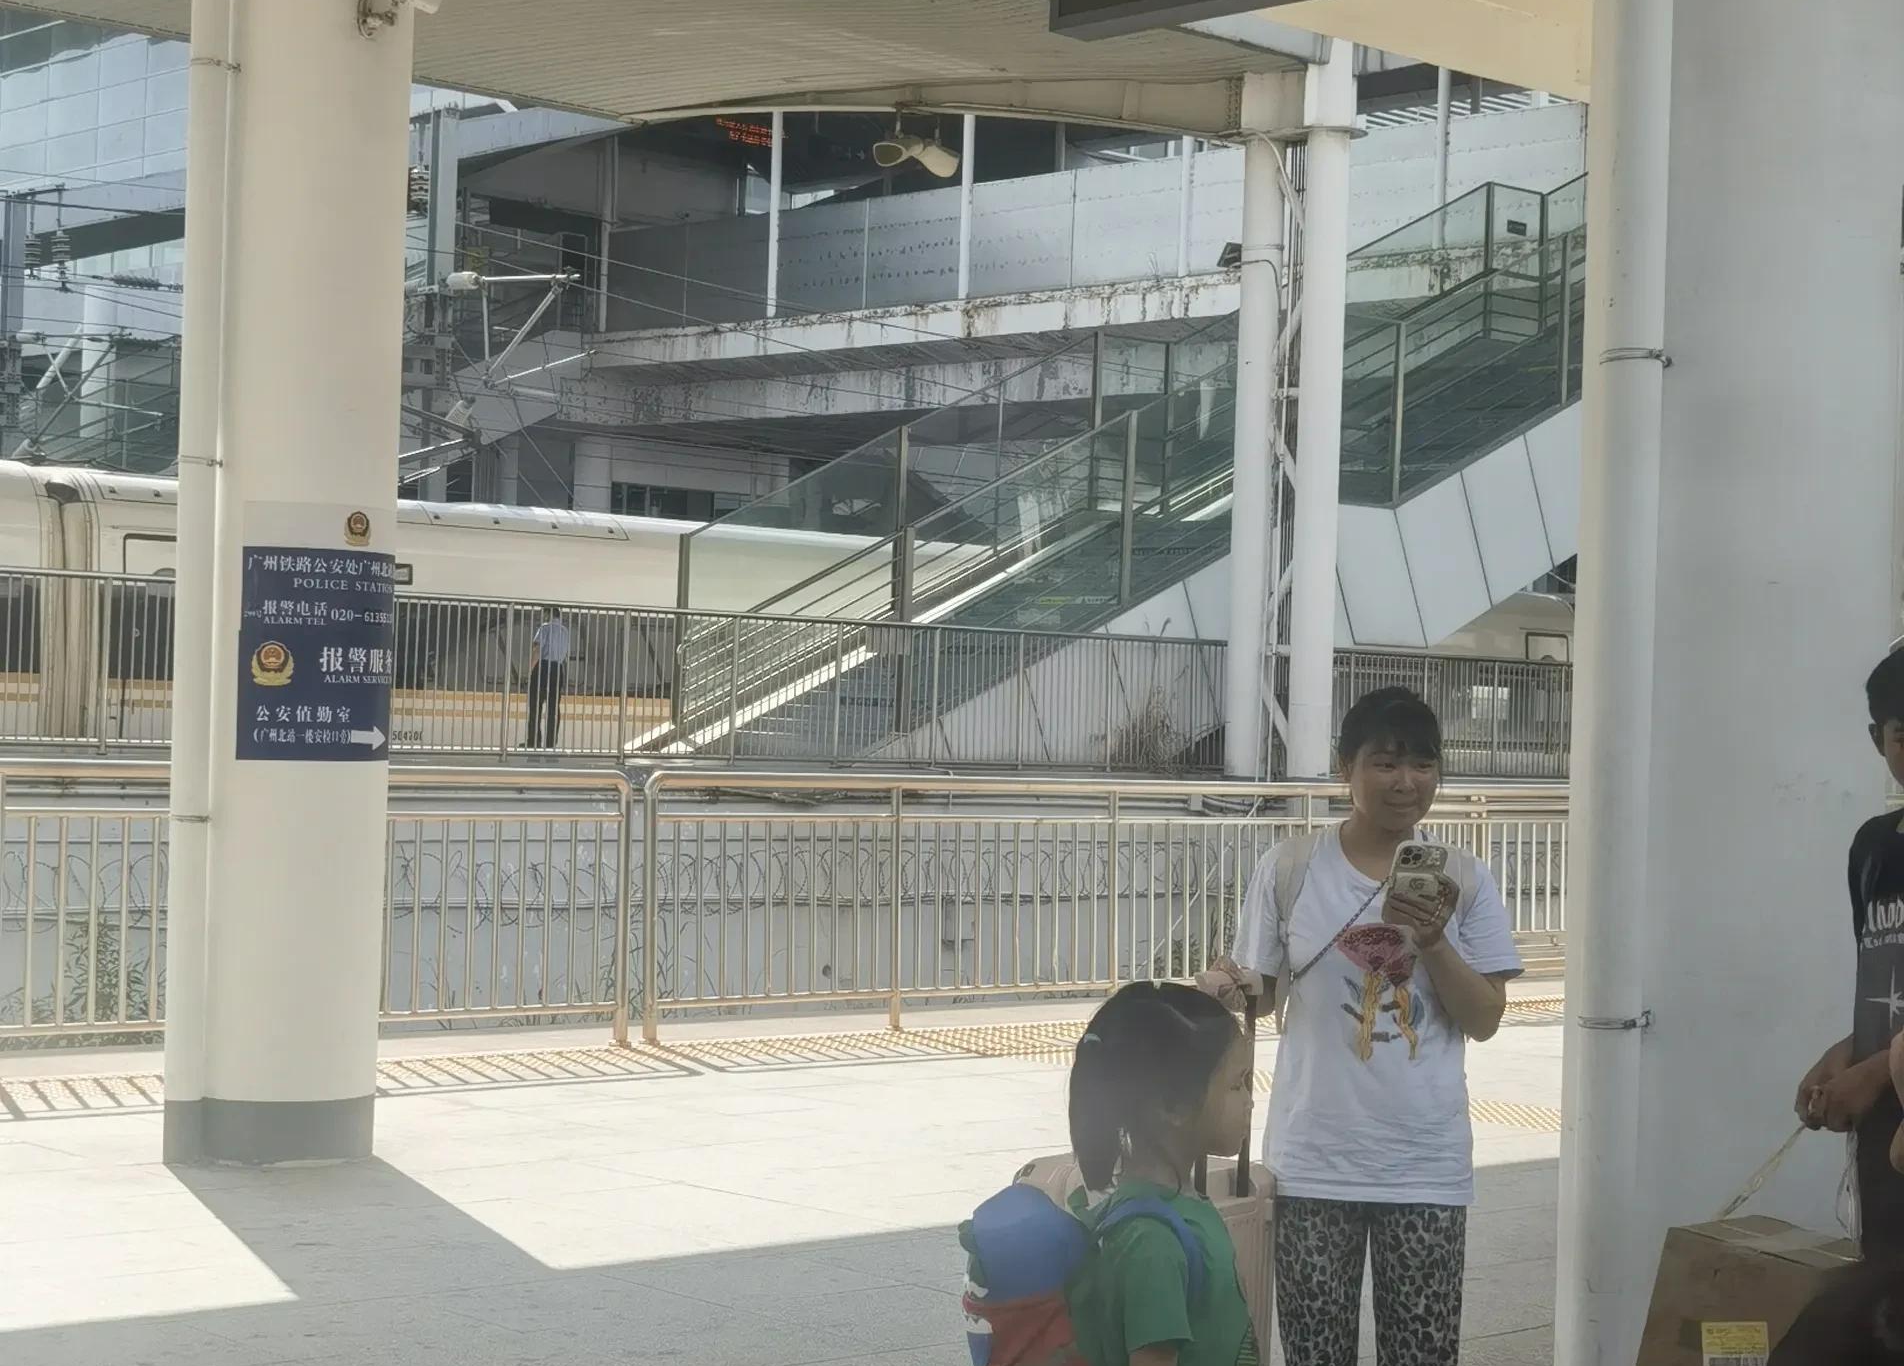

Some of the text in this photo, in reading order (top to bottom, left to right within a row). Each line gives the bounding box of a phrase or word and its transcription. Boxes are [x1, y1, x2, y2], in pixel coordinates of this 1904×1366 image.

[294, 578, 349, 590] POLICE
[262, 599, 328, 617] 报警电话
[263, 616, 327, 626] ALARM TEL
[324, 674, 360, 684] ALARM
[256, 705, 351, 723] 公安值勤室
